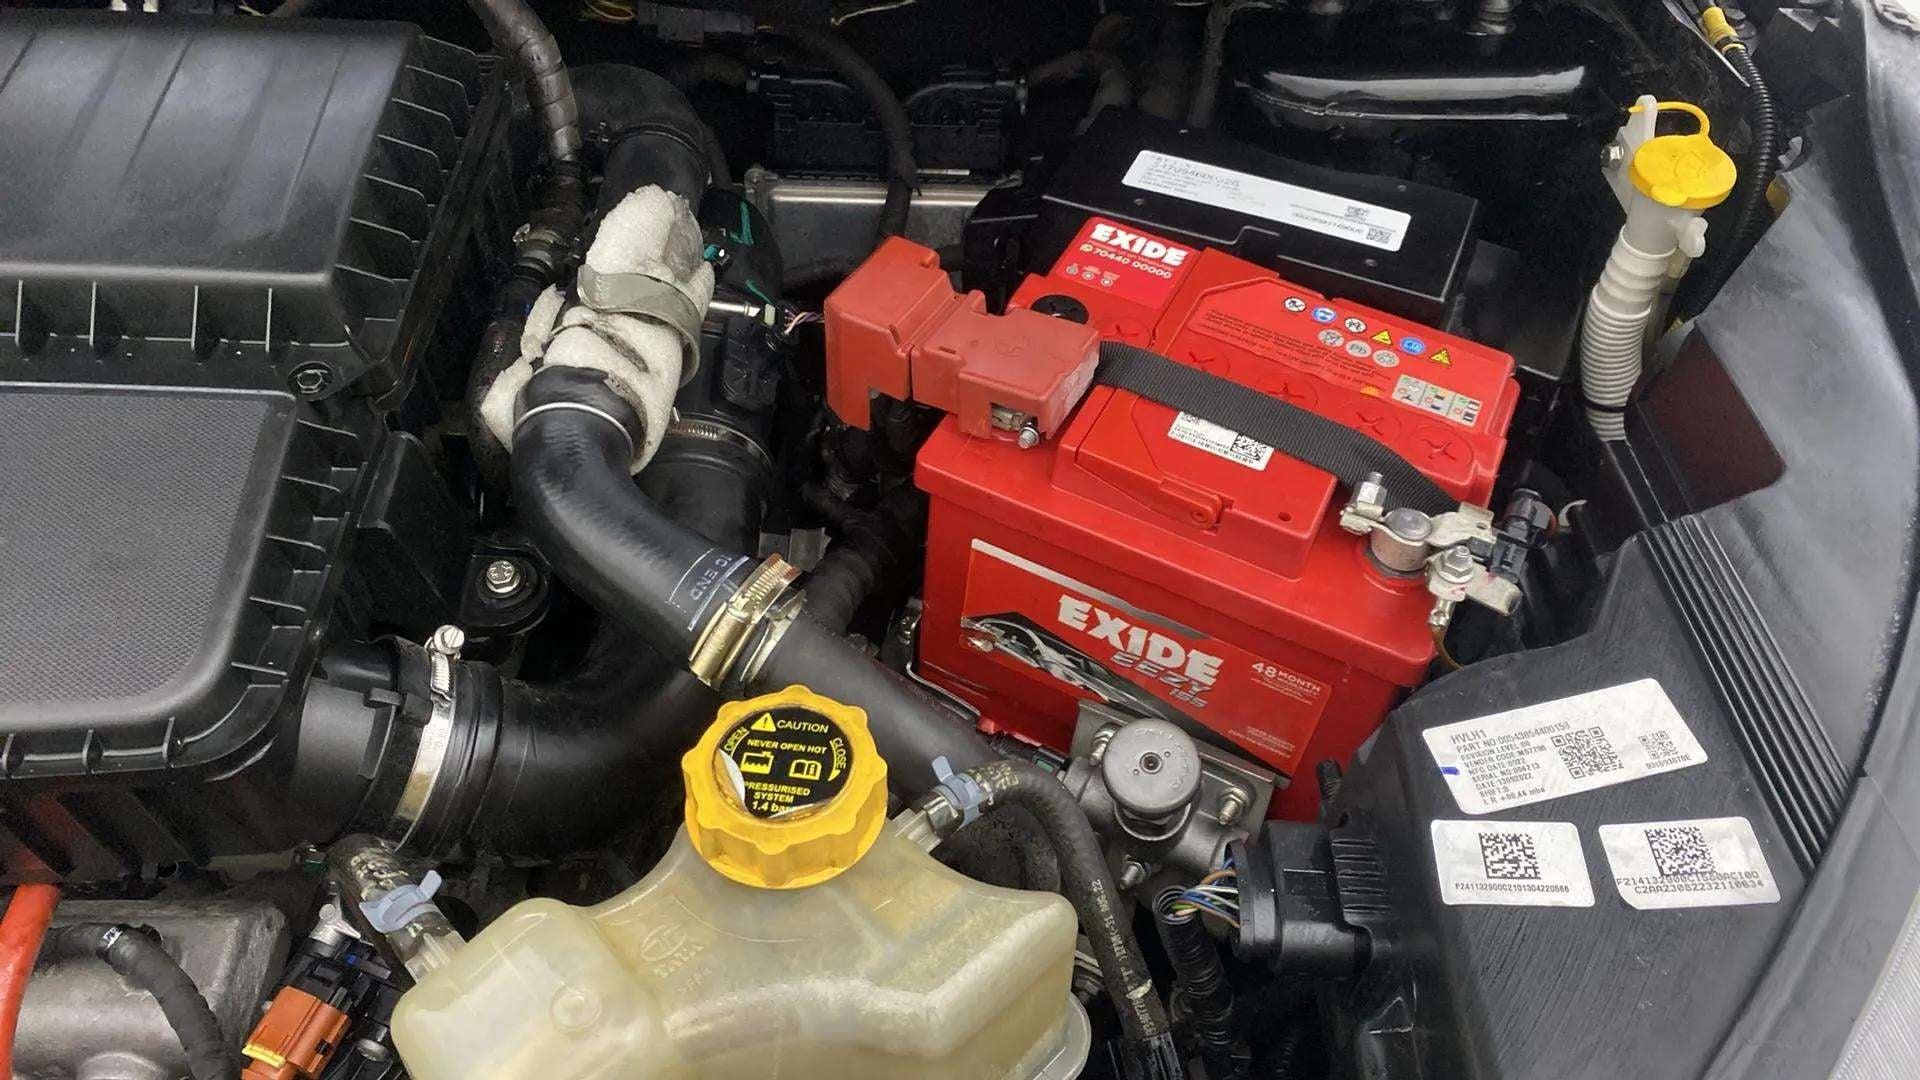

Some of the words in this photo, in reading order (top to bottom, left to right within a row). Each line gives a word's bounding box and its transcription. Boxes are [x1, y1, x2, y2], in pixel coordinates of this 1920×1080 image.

[1090, 223, 1189, 267] EXIDE
[1093, 247, 1131, 265] 70440
[1131, 260, 1173, 280] 00000
[689, 567, 720, 601] END
[1058, 594, 1224, 686] EXIDE
[1251, 662, 1278, 678] 48
[1278, 670, 1321, 693] MONTH
[776, 719, 830, 734] CAUTION
[1450, 729, 1487, 745] HVLH1
[723, 726, 748, 752] OPEN
[747, 738, 779, 750] NEVER
[780, 742, 808, 753] OPEN
[807, 744, 828, 755] HOT
[1456, 742, 1481, 754] PART
[832, 737, 847, 770] CLOSE
[744, 780, 811, 797] PRESSURISED
[753, 792, 795, 804] SYSTEM
[752, 801, 769, 811] 1.4
